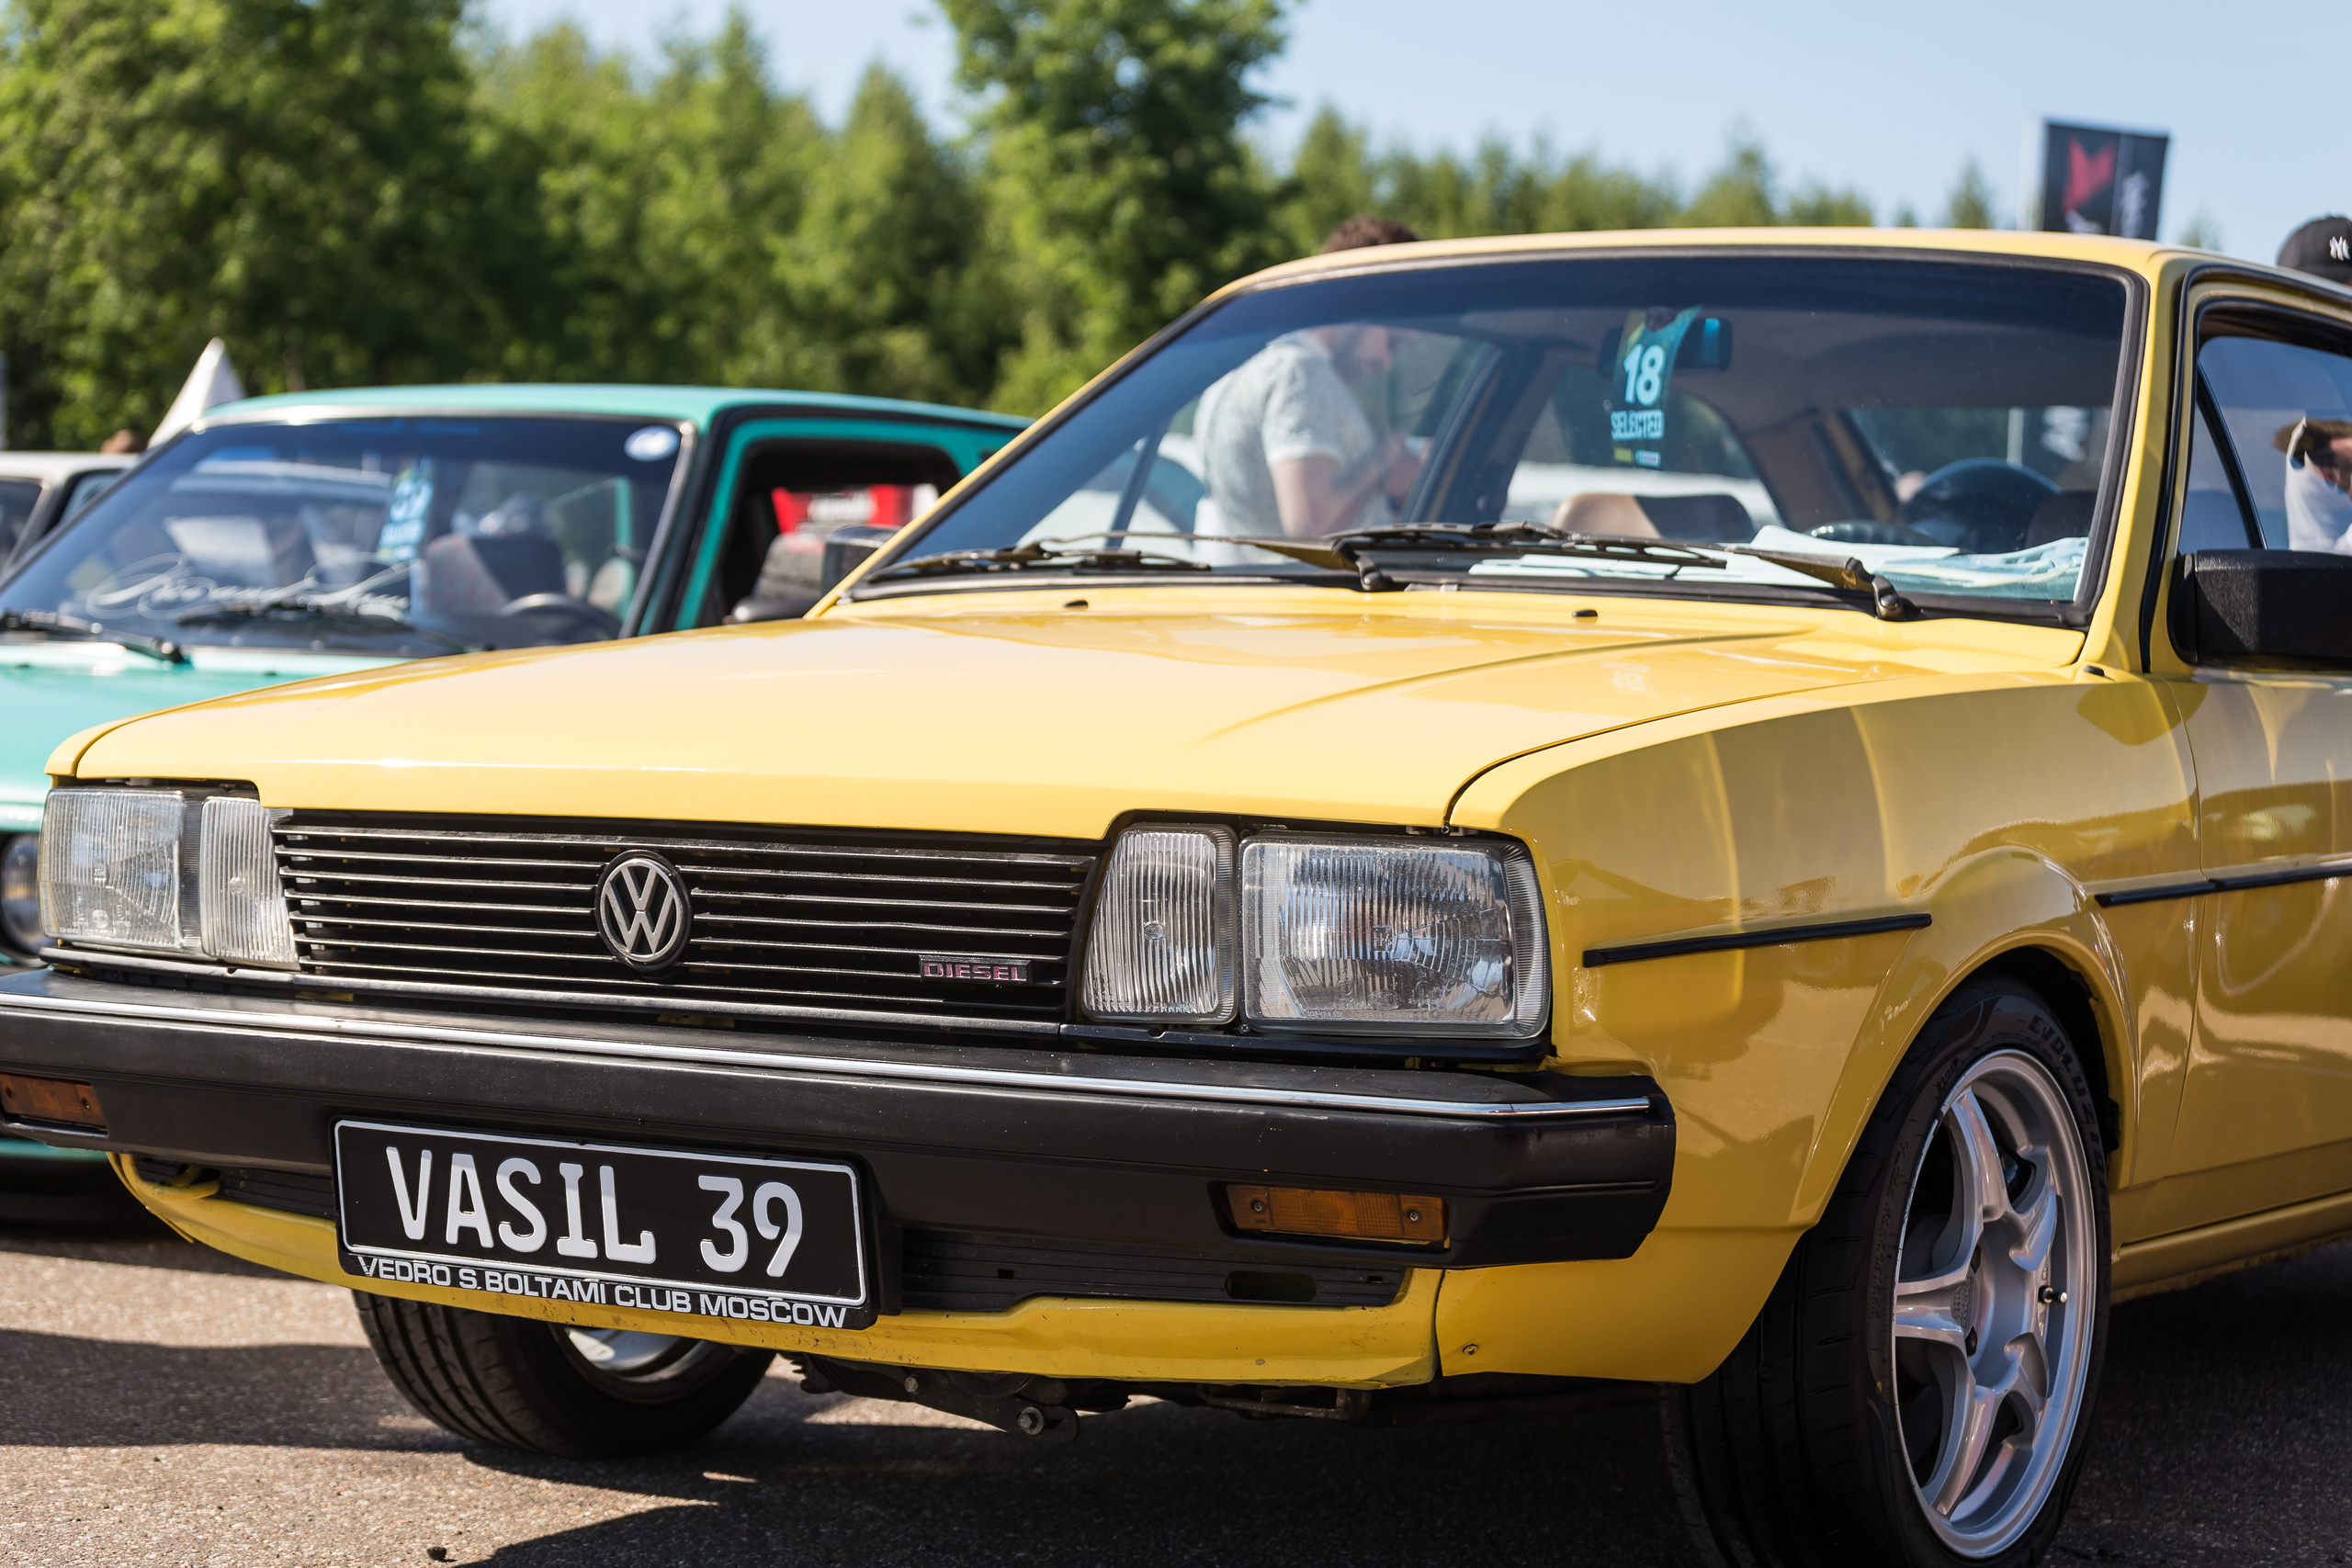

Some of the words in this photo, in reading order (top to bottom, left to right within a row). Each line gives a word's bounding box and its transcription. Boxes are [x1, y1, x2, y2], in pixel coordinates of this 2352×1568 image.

[1623, 344, 1666, 406] 18
[1611, 409, 1665, 441] SELECTED
[600, 858, 683, 962] VW
[923, 963, 1027, 982] DIESEL
[386, 1146, 656, 1264] VASIL
[698, 1175, 803, 1278] 39
[357, 1256, 451, 1286] VEDRO
[484, 1271, 606, 1303] BOLTAMI
[615, 1285, 692, 1313] CLUB
[699, 1293, 846, 1327] MOSCOW
